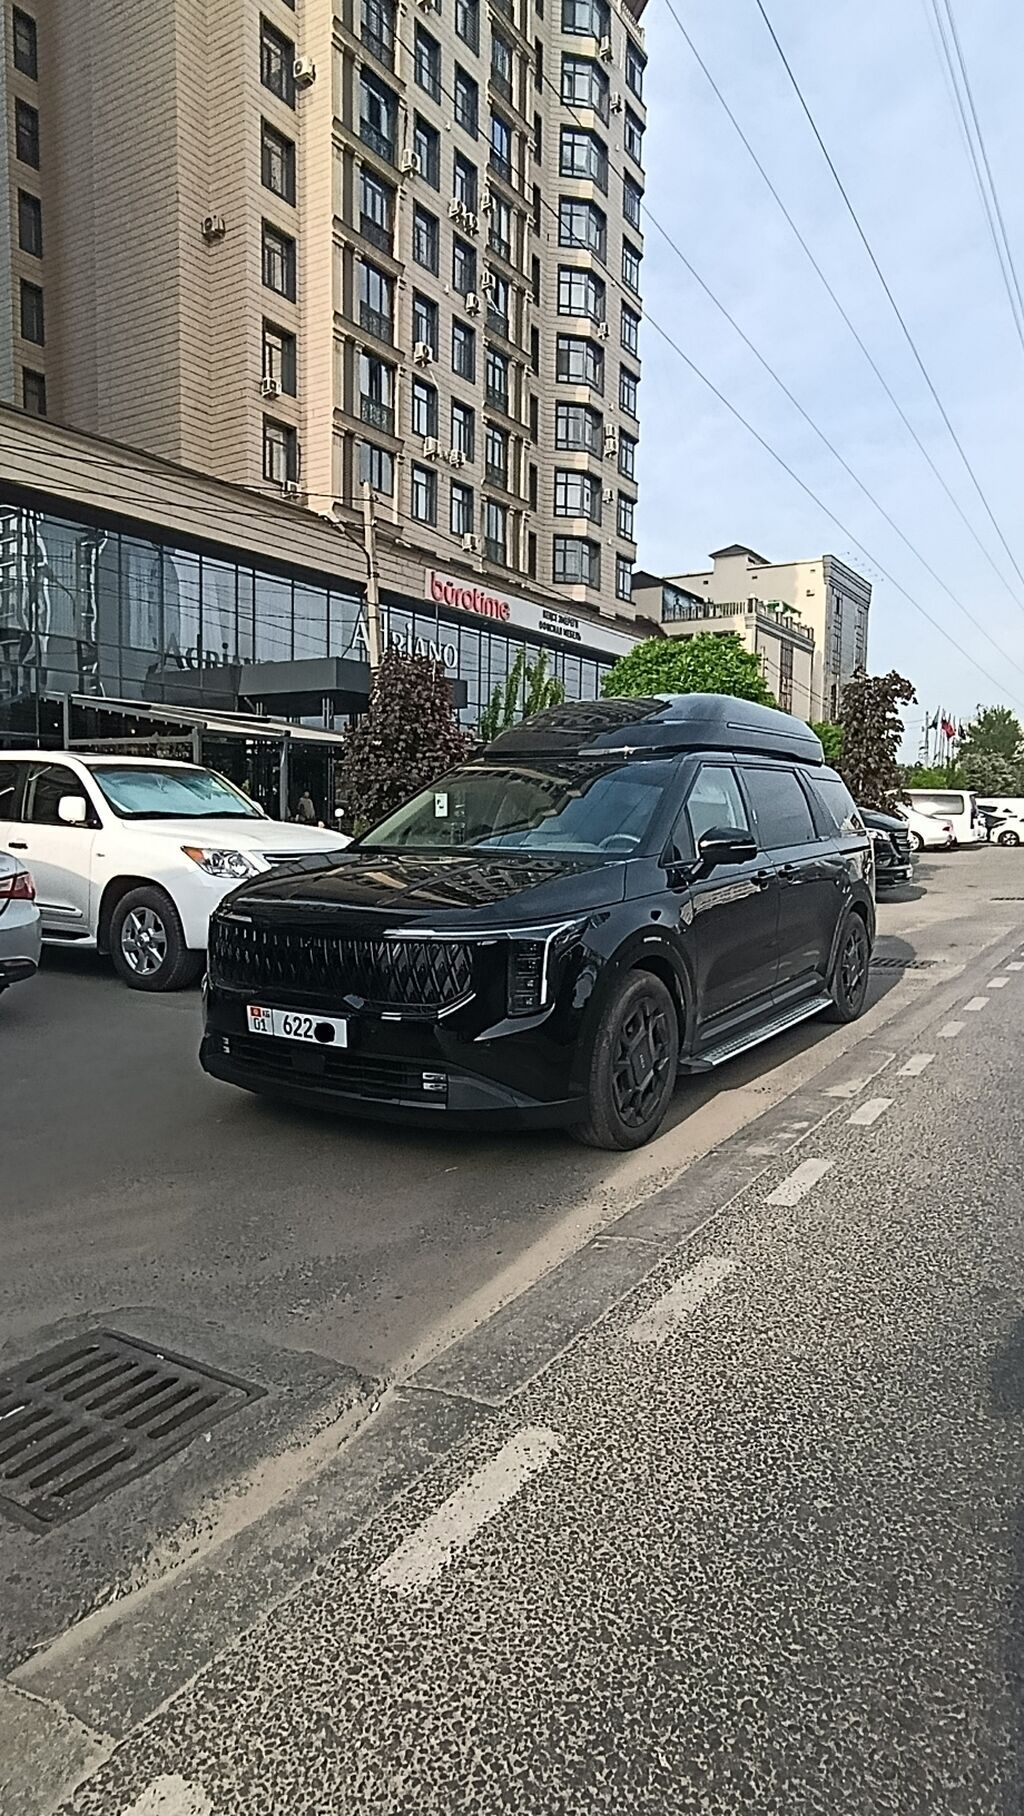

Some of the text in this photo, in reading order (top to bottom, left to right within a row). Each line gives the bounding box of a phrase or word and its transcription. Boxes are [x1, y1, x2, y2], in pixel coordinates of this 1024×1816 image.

[431, 571, 511, 621] bürotime
[253, 1014, 313, 1039] 01 622
